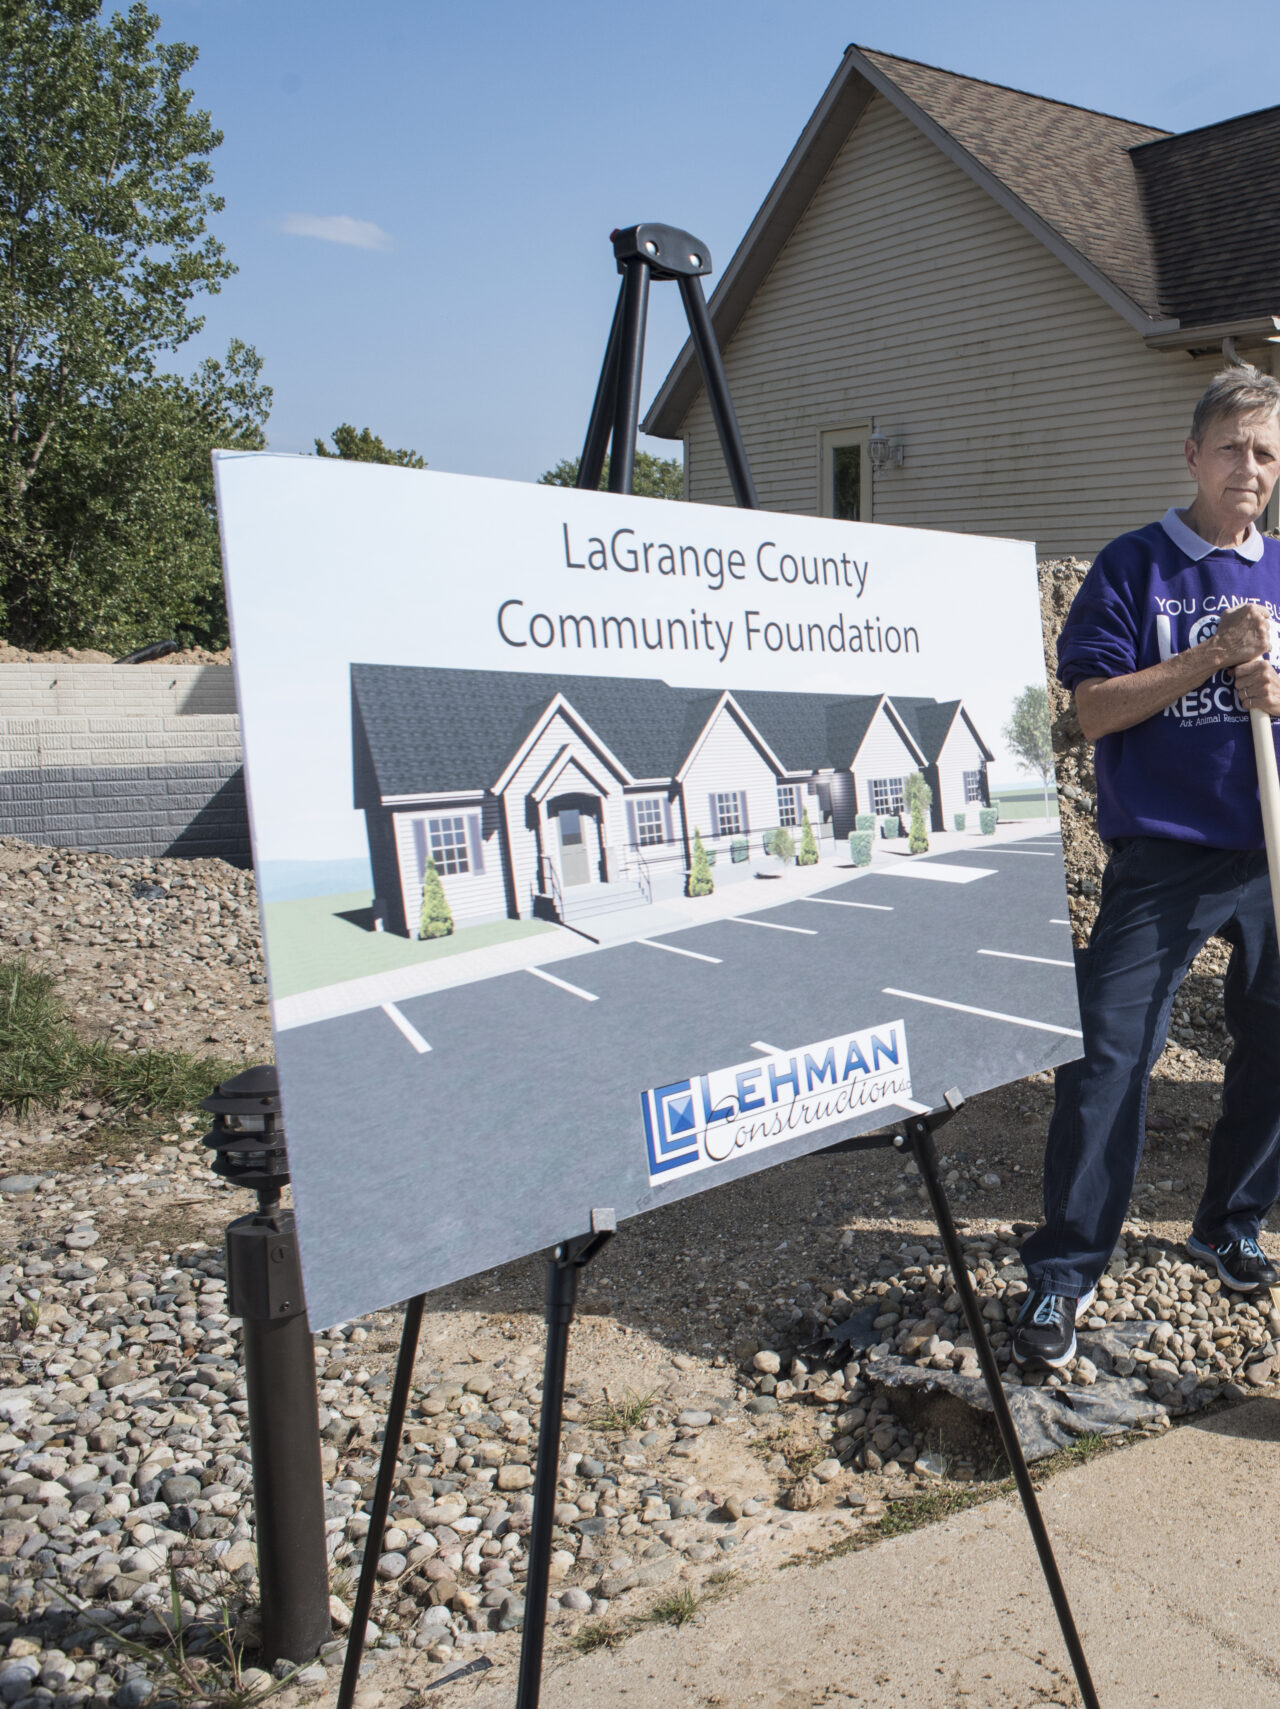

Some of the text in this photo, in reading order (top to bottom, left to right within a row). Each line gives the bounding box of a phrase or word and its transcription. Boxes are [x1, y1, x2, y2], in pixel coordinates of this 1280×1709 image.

[562, 522, 869, 599] LaGrange County
[497, 599, 920, 663] Community Foundation
[1154, 596, 1196, 616] YOU
[1179, 713, 1250, 728] Ark Animal Rescue
[700, 1029, 899, 1124] LEHMAN
[704, 1075, 903, 1161] Construction
